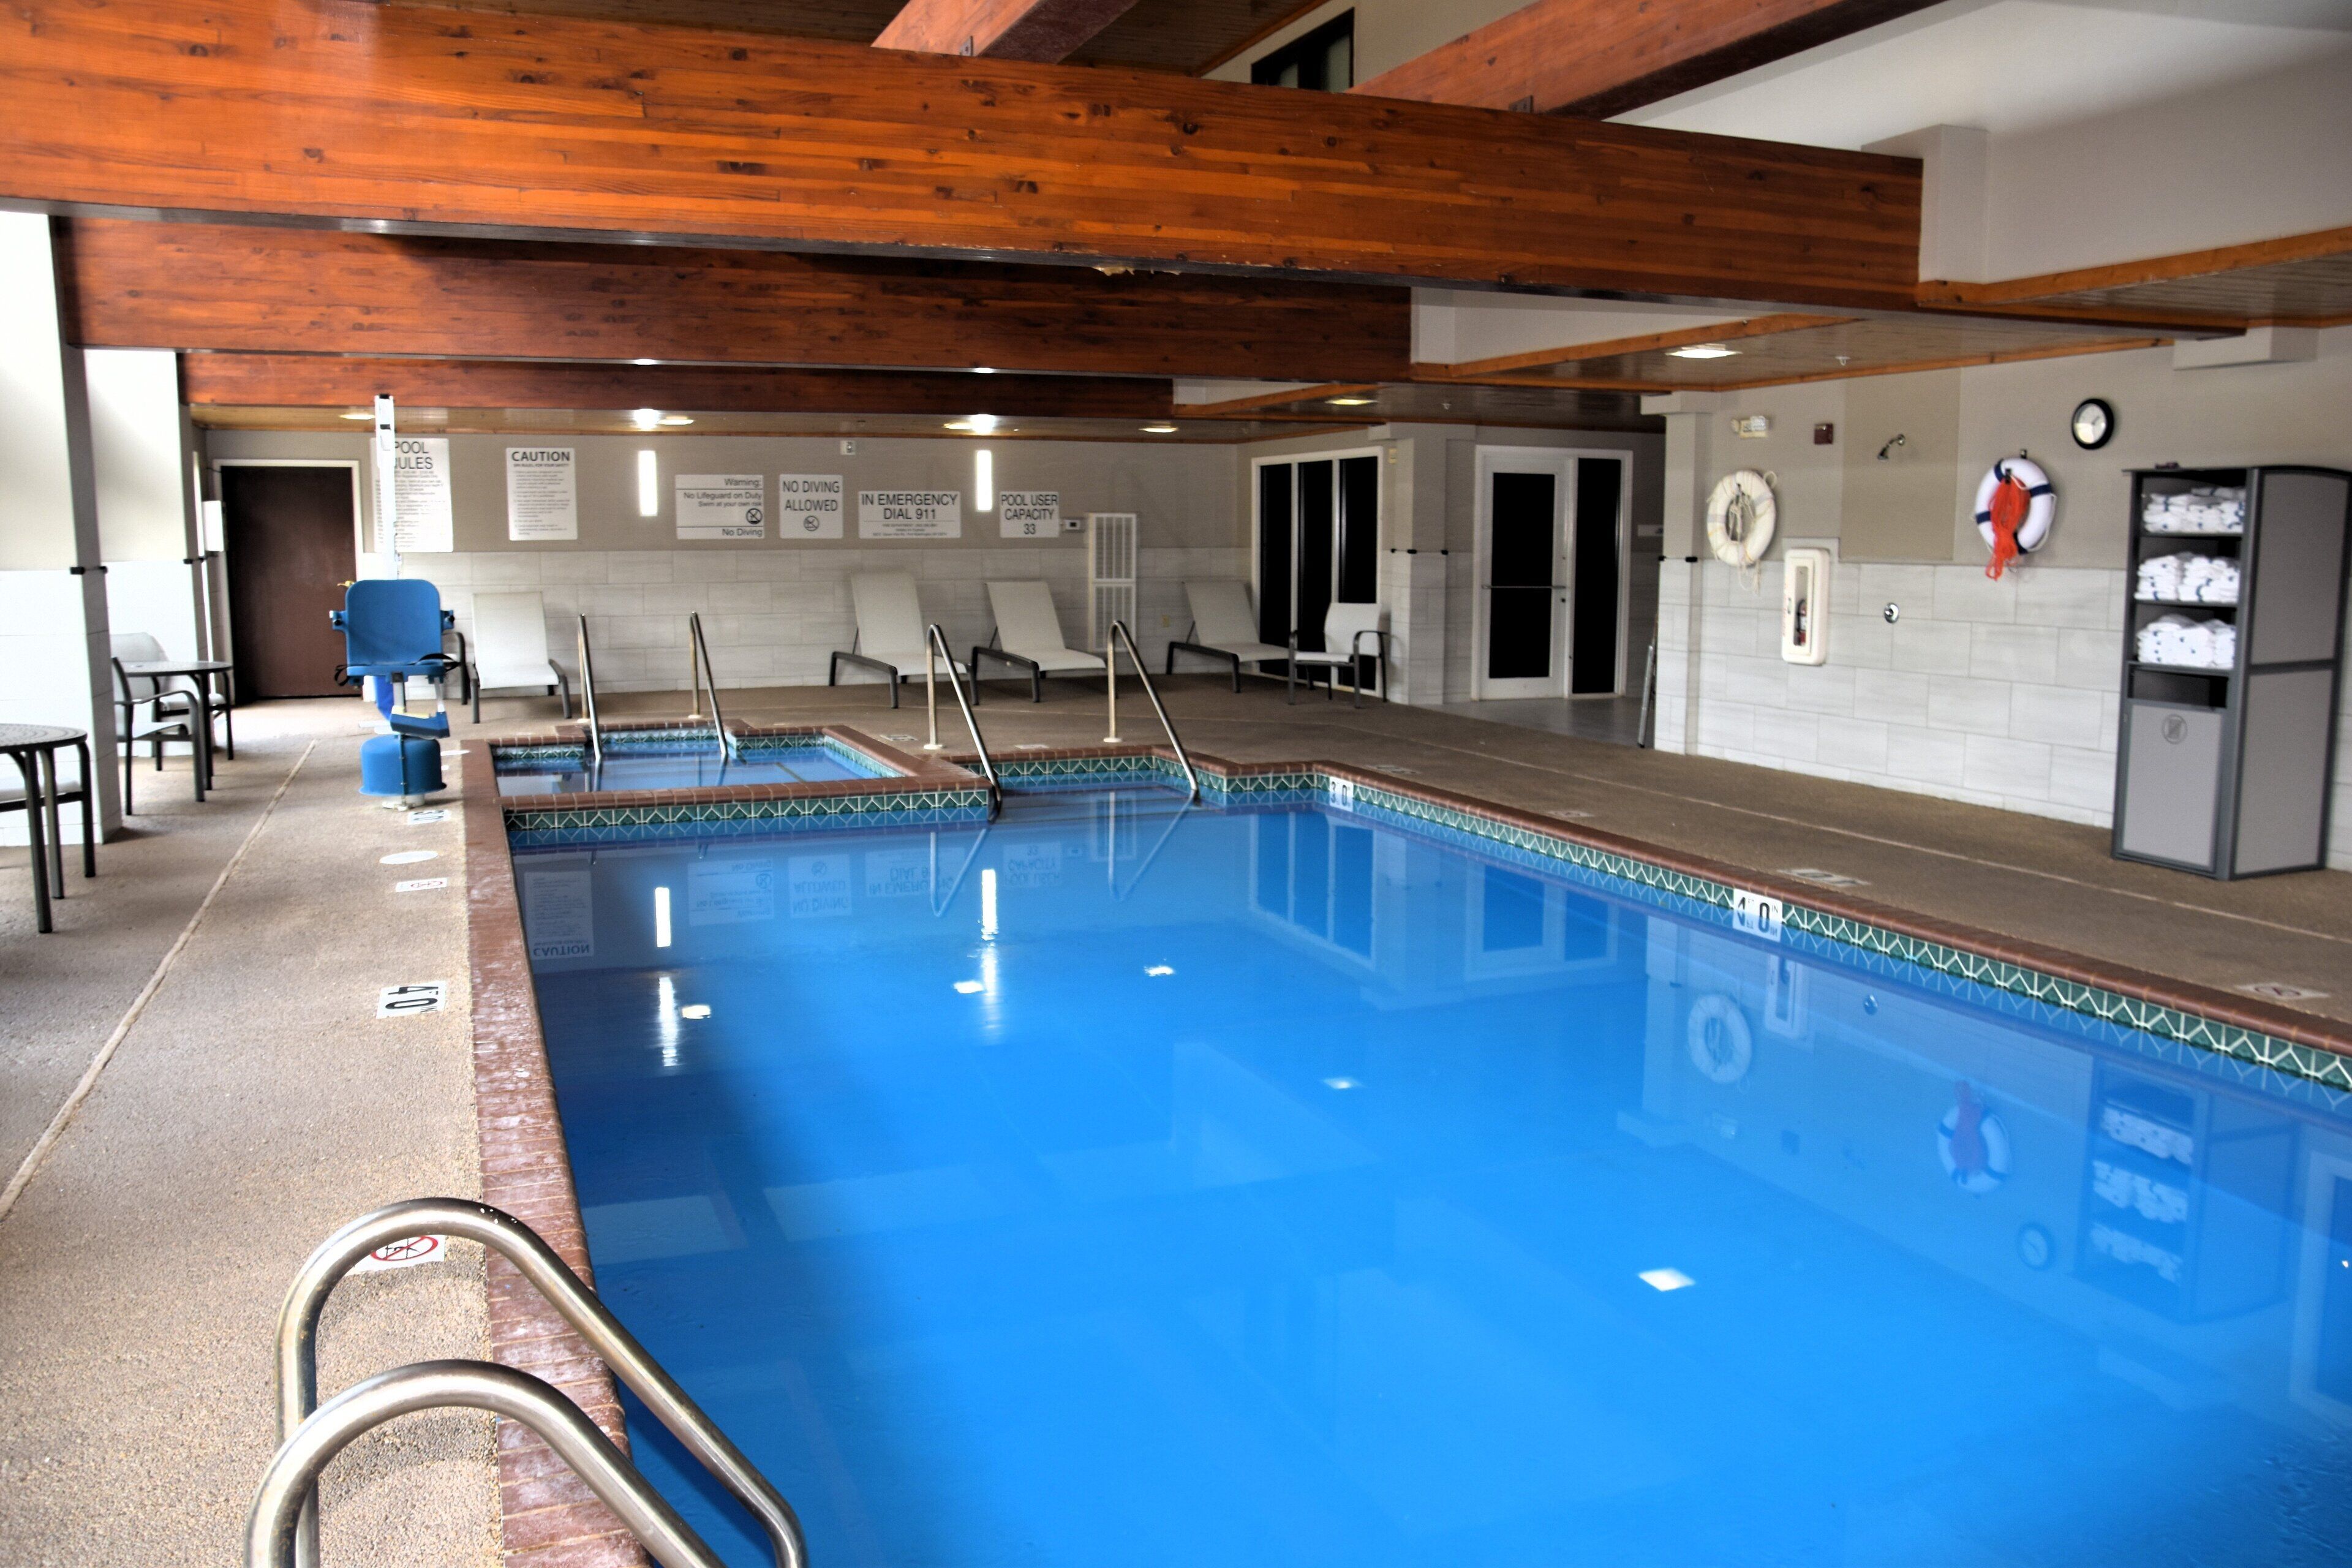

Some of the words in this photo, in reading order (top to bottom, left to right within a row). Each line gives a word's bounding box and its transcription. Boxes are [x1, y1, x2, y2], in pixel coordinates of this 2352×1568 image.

[511, 451, 570, 461] CAUTION
[395, 457, 433, 469] ULES
[724, 478, 761, 488] Warning:
[783, 480, 799, 492] NO
[802, 480, 840, 493] DIVING
[785, 499, 838, 511] ALLOWED
[861, 494, 874, 505] IN
[877, 494, 957, 505] EMERGENCY
[1001, 494, 1028, 506] POOL
[1030, 494, 1058, 506] USER
[883, 508, 912, 519] DIAL
[916, 508, 936, 519] 911
[1005, 508, 1054, 520] CAPACITY
[736, 529, 763, 538] Diving
[1023, 523, 1036, 535] 33
